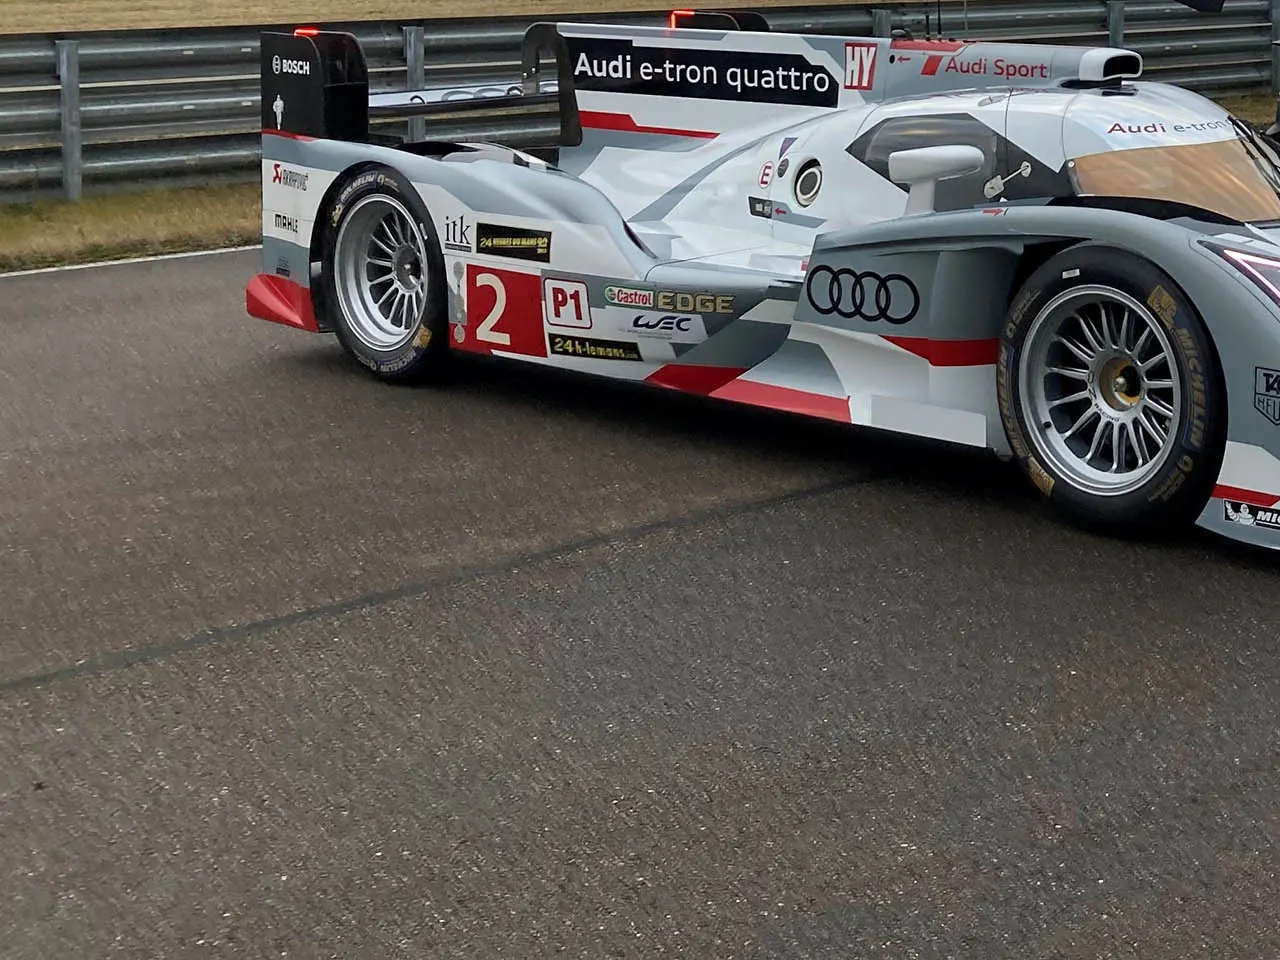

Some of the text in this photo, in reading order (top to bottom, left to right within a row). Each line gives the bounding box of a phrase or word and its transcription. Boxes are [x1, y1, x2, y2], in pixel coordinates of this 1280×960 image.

[282, 59, 310, 76] BOSCH
[574, 52, 831, 92] Audi e-tron quattro
[845, 46, 876, 87] HY
[945, 56, 1048, 80] Audi Sport
[1108, 123, 1167, 134] Audi
[1173, 119, 1226, 133] e-tron
[760, 165, 772, 185] E
[275, 213, 299, 234] MAHLE
[445, 215, 472, 245] itk
[476, 273, 511, 346] 2
[552, 287, 583, 321] P1
[616, 289, 736, 313] Castrol EDGE
[632, 315, 692, 332] WEC
[554, 338, 573, 353] 24
